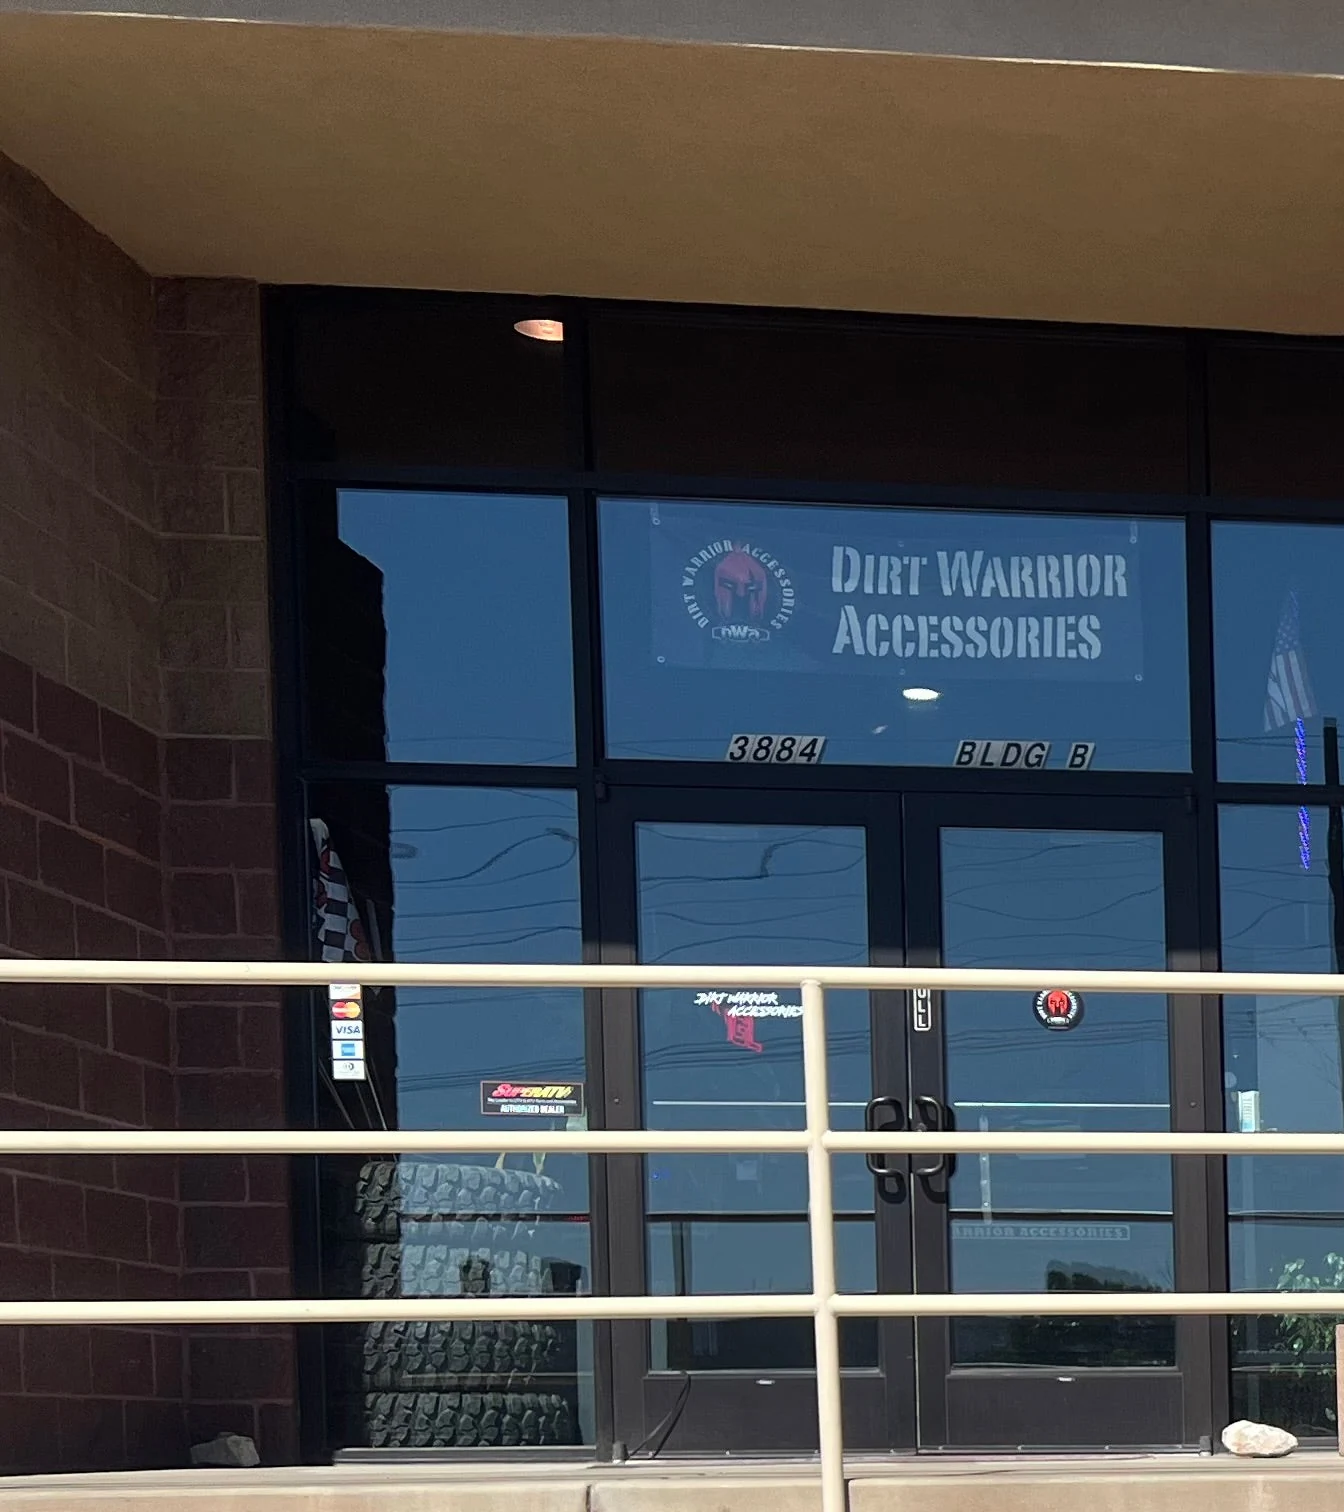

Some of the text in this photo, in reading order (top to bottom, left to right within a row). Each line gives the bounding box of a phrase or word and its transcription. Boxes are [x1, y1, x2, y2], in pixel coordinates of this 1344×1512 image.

[682, 539, 795, 630] DIRT WARRIOR ACCESSORIES
[831, 545, 1128, 598] DIRT WARRIOR
[832, 604, 1102, 660] ACCESSORIES
[728, 736, 819, 762] 3884
[956, 742, 1088, 769] BLDG B
[335, 1025, 361, 1035] VISA
[952, 1226, 1015, 1238] ARRIOR
